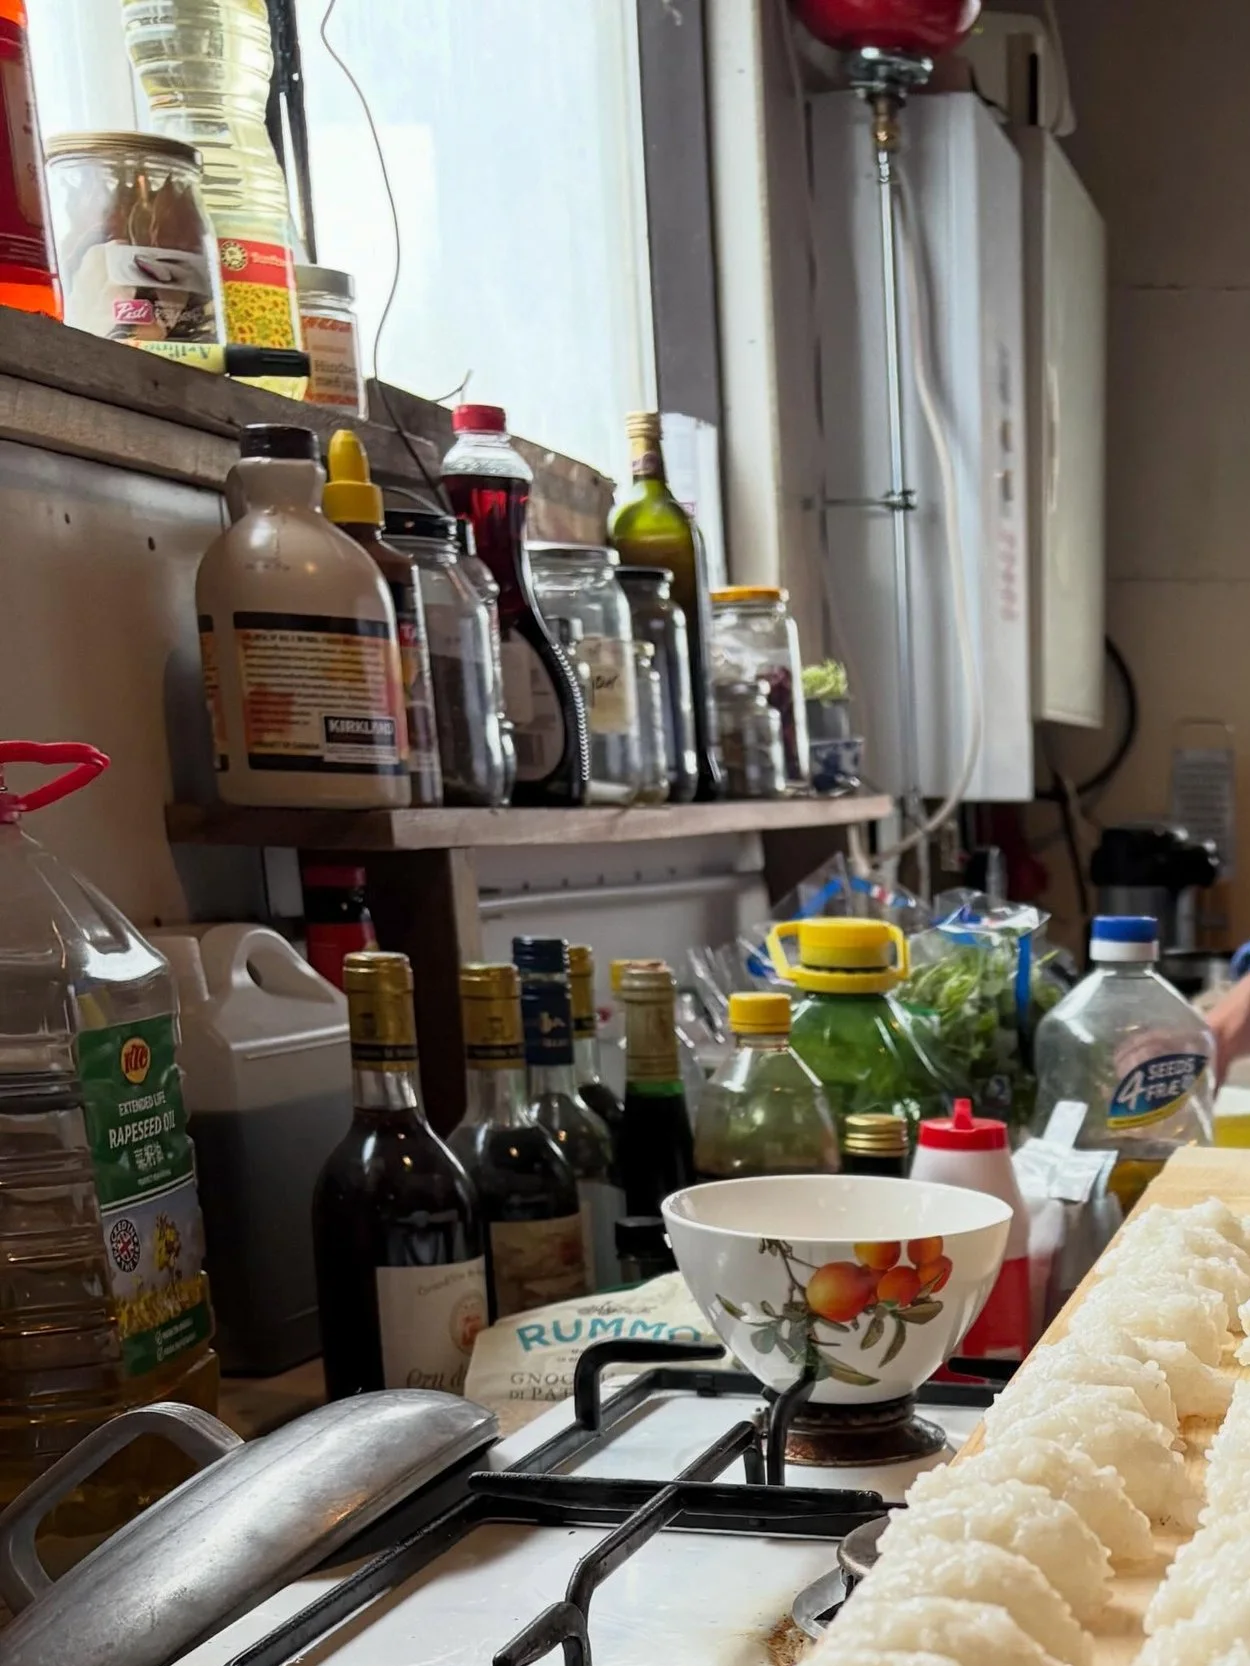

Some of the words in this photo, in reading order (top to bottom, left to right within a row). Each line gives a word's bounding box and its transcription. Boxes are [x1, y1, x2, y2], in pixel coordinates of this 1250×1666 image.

[118, 1095, 154, 1117] EXTENDED
[109, 1115, 162, 1149] RAPESEED
[163, 1110, 176, 1131] OIL
[516, 1317, 701, 1352] RUMMO
